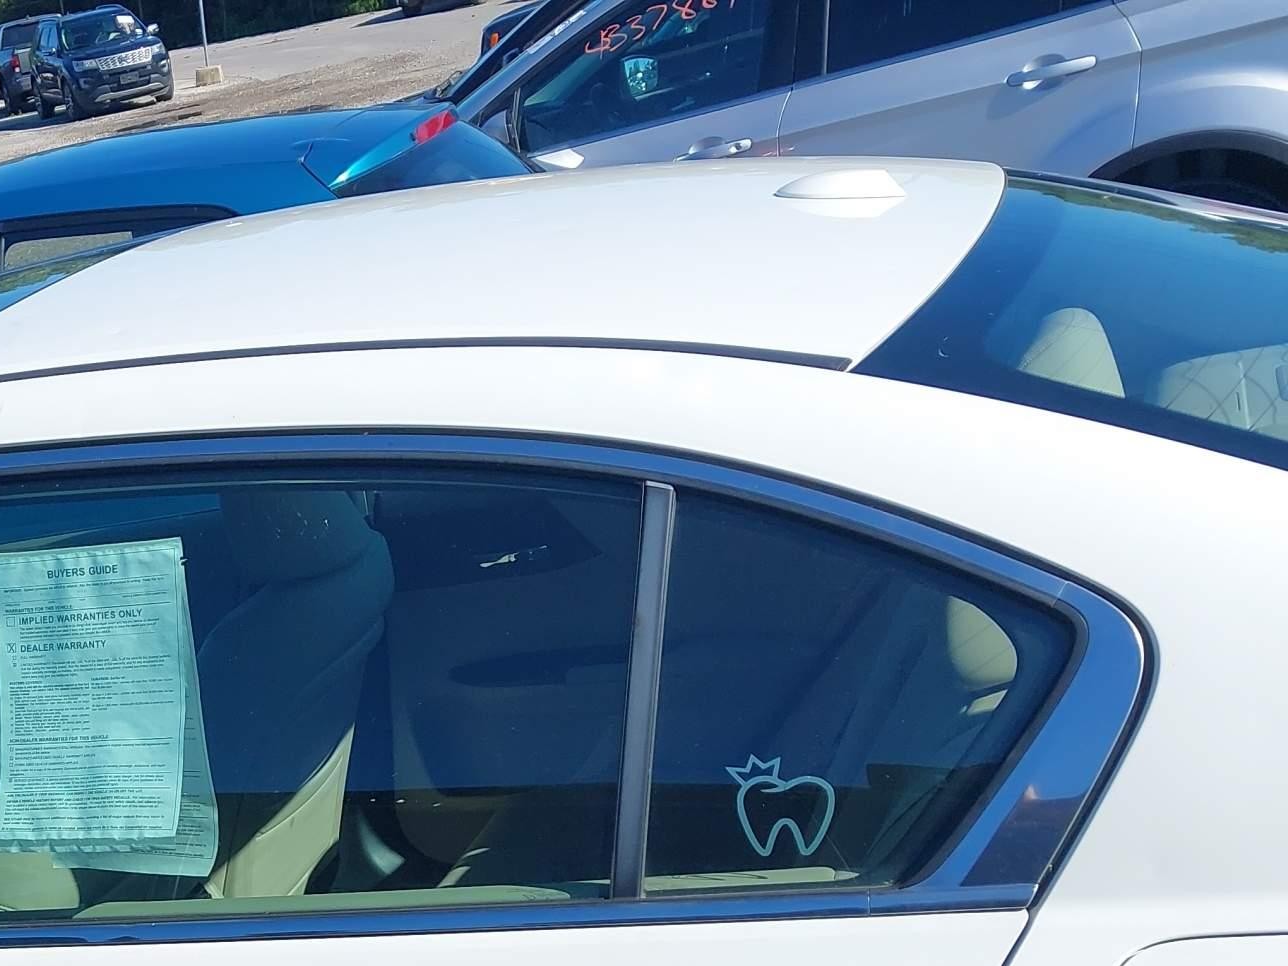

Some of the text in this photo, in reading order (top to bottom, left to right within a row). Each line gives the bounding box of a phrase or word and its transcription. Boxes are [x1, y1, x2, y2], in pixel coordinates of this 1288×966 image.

[47, 564, 118, 579] BUYERS GUIDE
[19, 608, 143, 625] IMPLIED WARRANTIES ONLY
[20, 643, 55, 653] DEALER
[56, 639, 107, 651] WARRANTY
